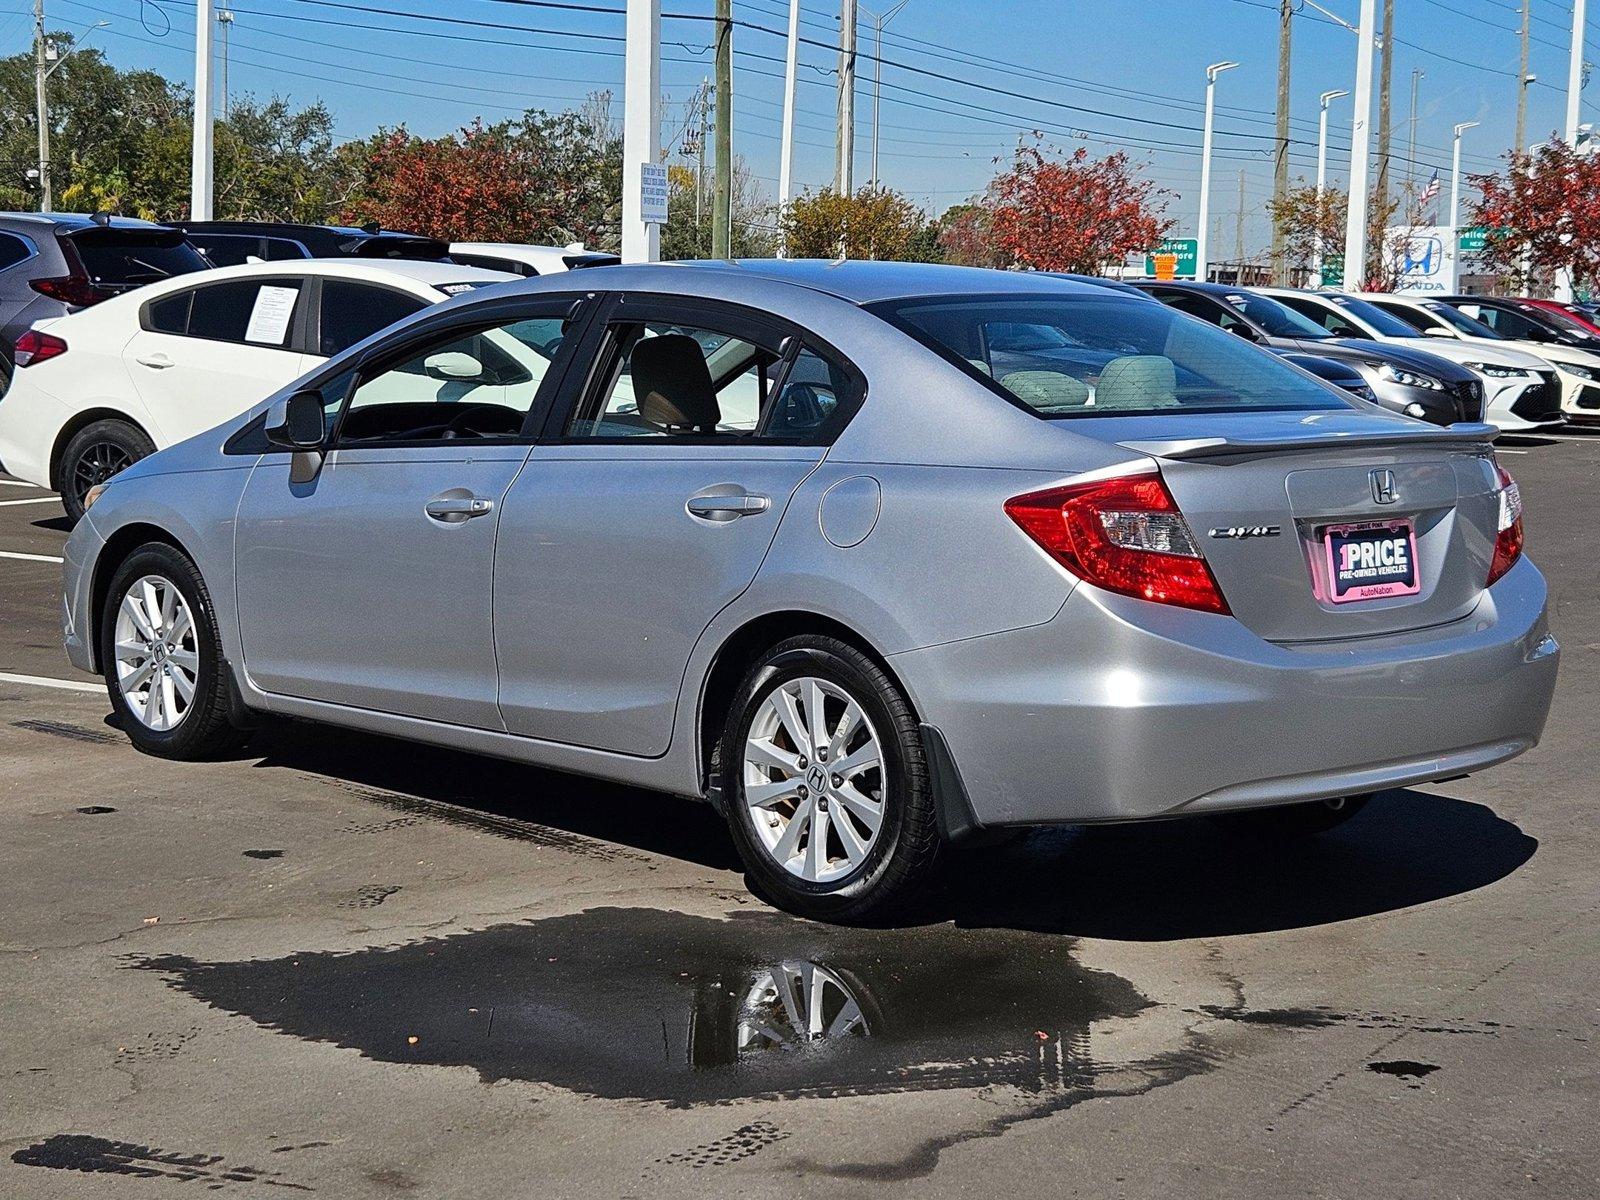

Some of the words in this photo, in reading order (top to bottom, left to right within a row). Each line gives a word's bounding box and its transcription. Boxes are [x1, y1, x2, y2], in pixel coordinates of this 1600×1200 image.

[1158, 242, 1188, 251] aines
[1397, 282, 1446, 291] ONDA
[1340, 538, 1408, 571] 1PRICE
[1339, 568, 1377, 580] PRE-OWNED
[1378, 564, 1408, 576] VEHICLES
[1360, 586, 1394, 598] AutoNation
